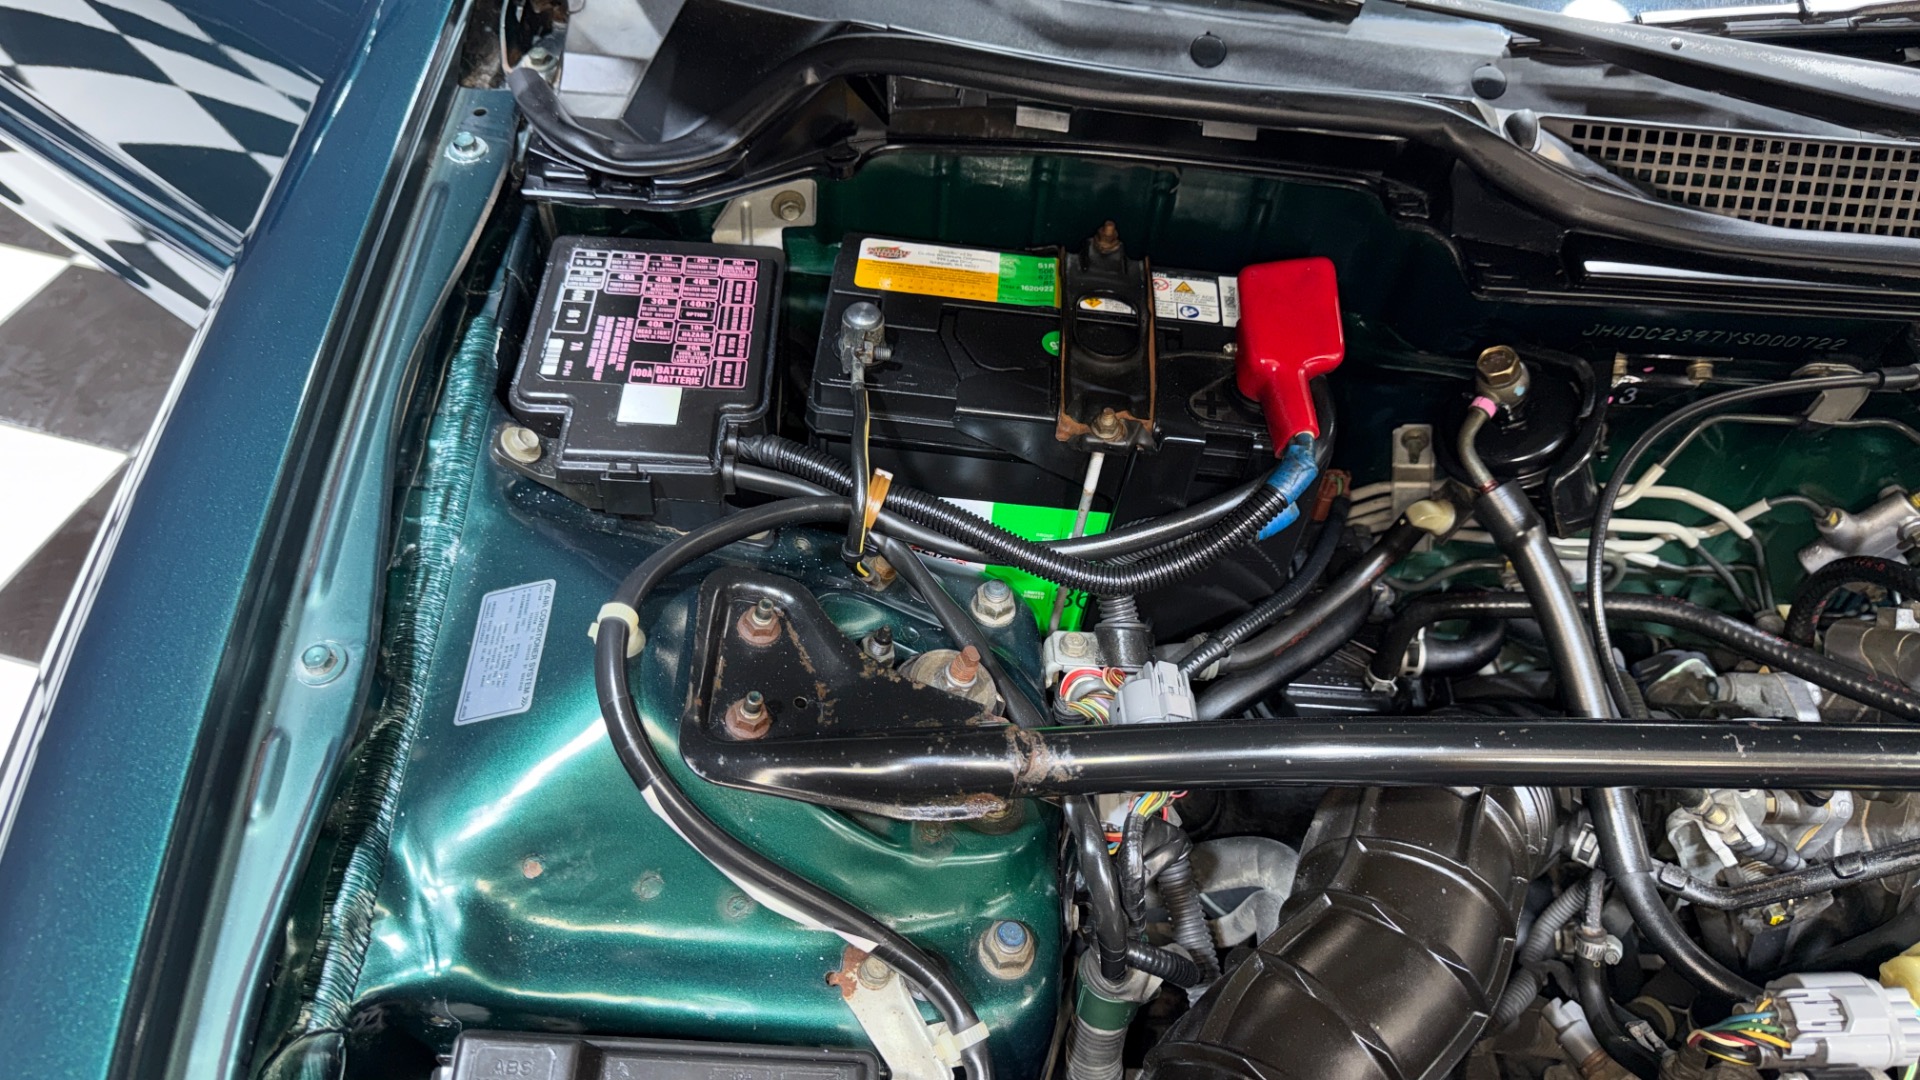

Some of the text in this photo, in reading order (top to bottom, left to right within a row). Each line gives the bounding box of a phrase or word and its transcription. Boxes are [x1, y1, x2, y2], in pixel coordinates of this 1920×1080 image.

[1020, 284, 1055, 292] 1620922
[646, 320, 665, 328] 40A
[1582, 323, 1847, 351] JH4DC2397YS000722
[632, 366, 653, 378] 100A
[655, 365, 705, 377] BATTERY
[656, 374, 701, 386] BATTERIE
[1619, 387, 1637, 404] 3
[532, 608, 547, 659] CONDITIONER
[523, 661, 537, 694] SYSTEM
[492, 1058, 533, 1076] ABS
